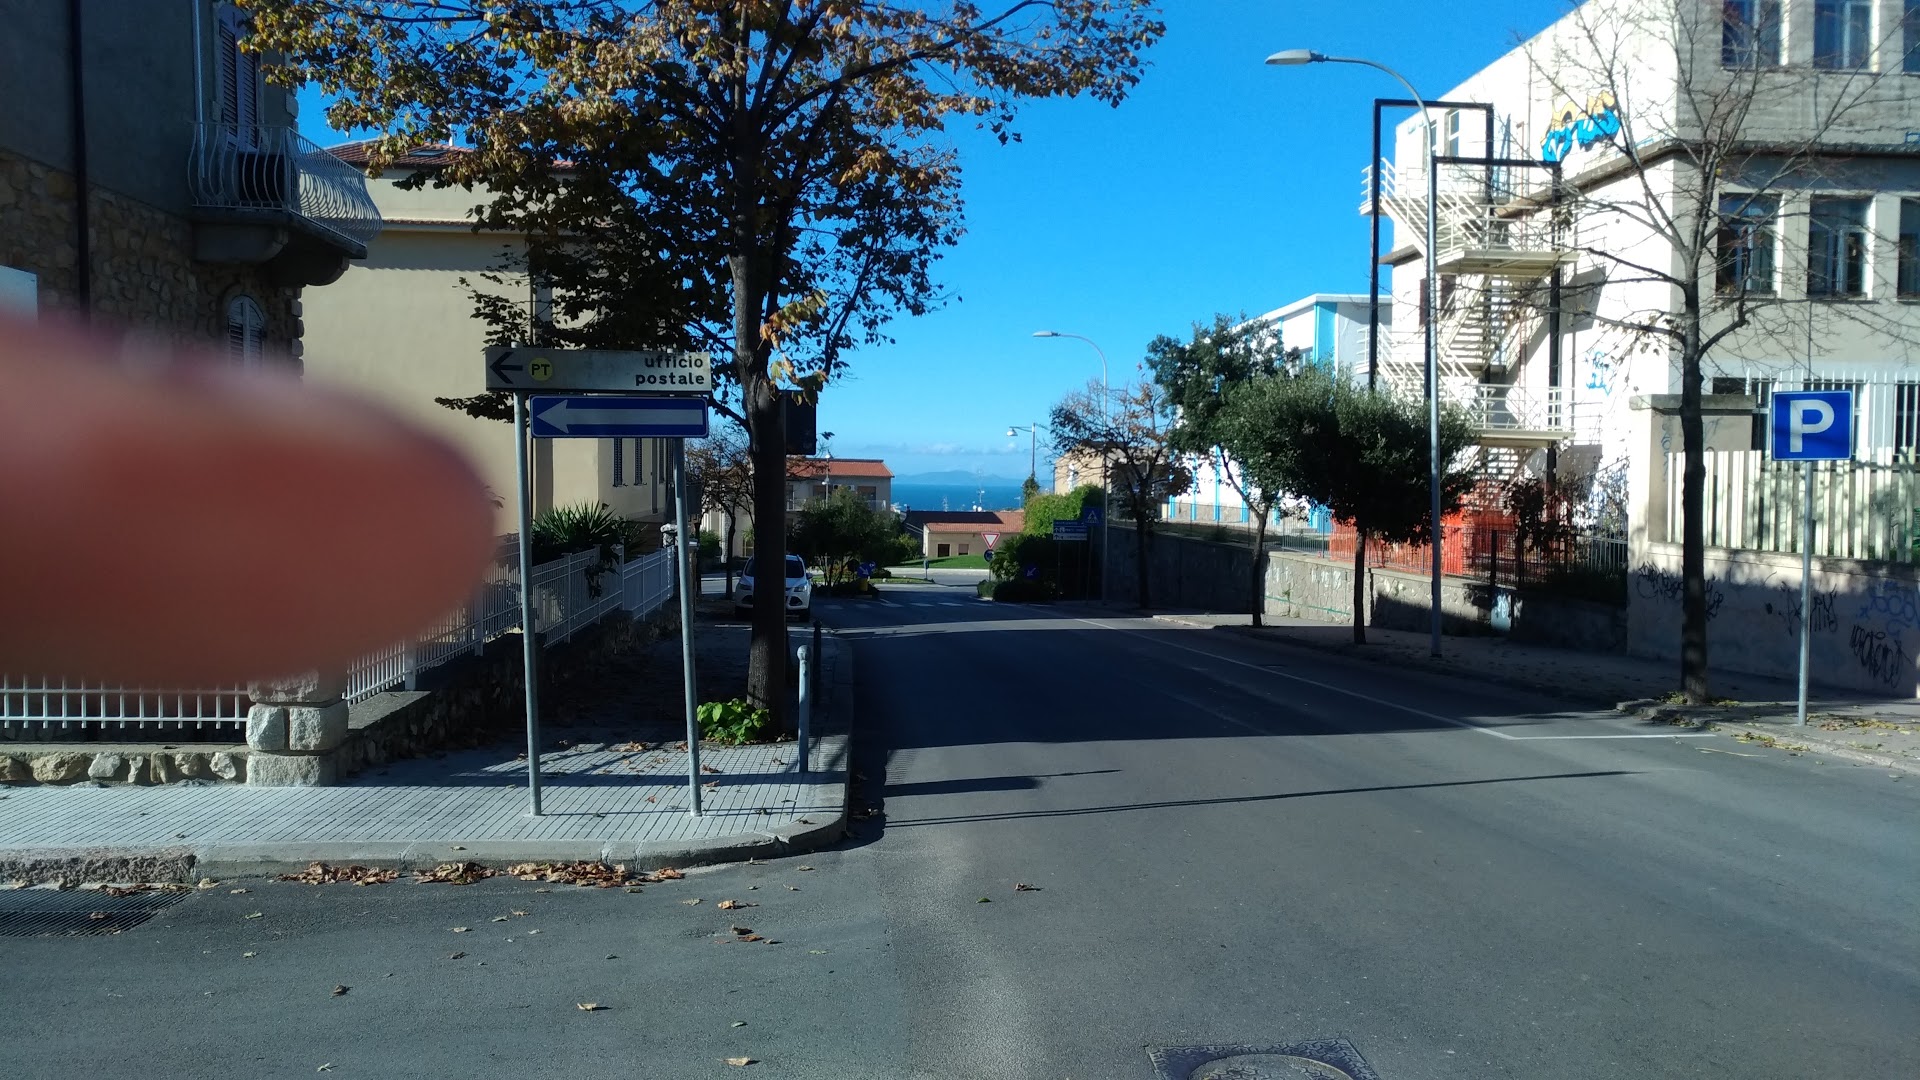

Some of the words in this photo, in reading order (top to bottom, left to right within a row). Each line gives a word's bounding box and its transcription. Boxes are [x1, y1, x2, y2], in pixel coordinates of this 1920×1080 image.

[645, 356, 704, 369] ufficio
[531, 363, 550, 376] PT
[635, 373, 705, 387] postale
[1790, 399, 1834, 453] P
